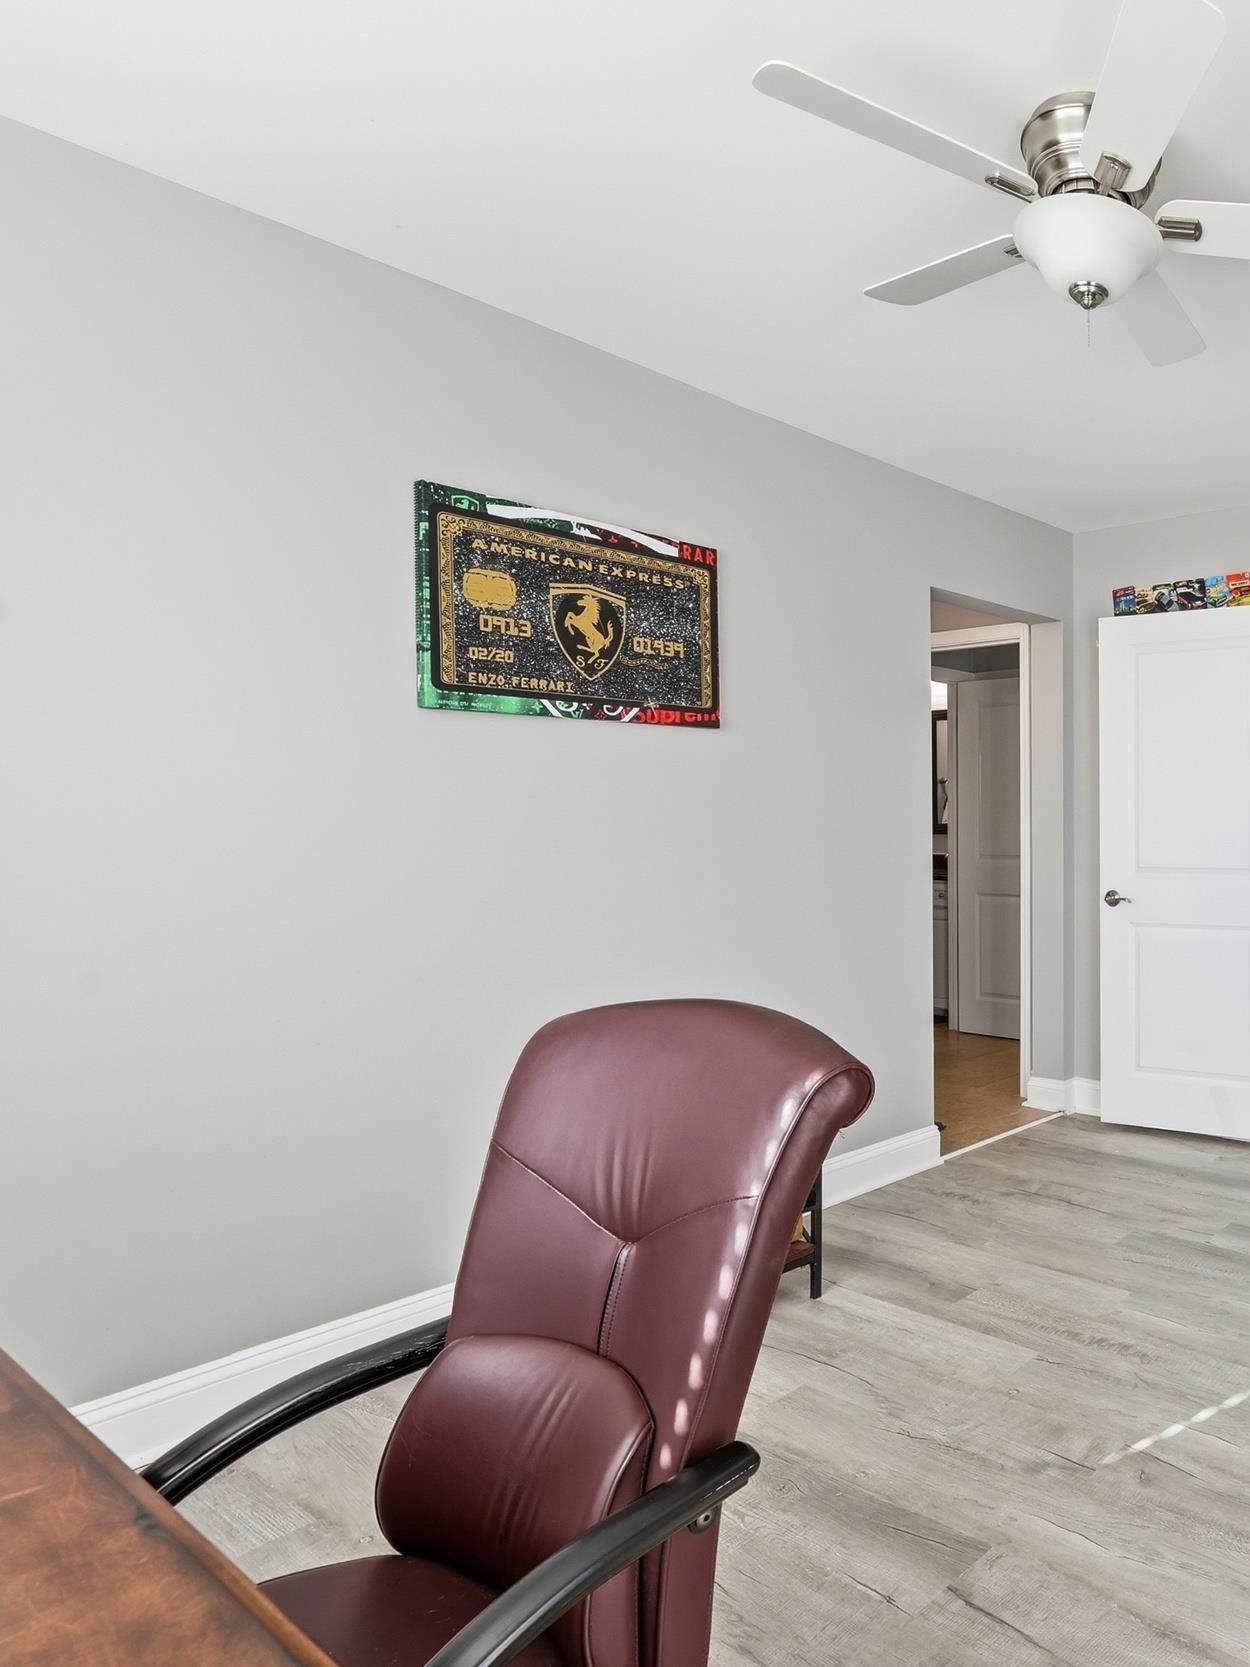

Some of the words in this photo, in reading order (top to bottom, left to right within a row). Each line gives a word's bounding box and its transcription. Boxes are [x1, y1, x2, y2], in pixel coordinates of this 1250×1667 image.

[471, 538, 593, 571] AMERICAN
[599, 564, 685, 589] EXPRESS
[682, 544, 715, 566] RAR
[479, 614, 532, 638] 0913
[469, 646, 514, 663] 02/20
[576, 655, 586, 668] S
[468, 671, 506, 686] ENZO
[511, 675, 575, 694] FERRARI
